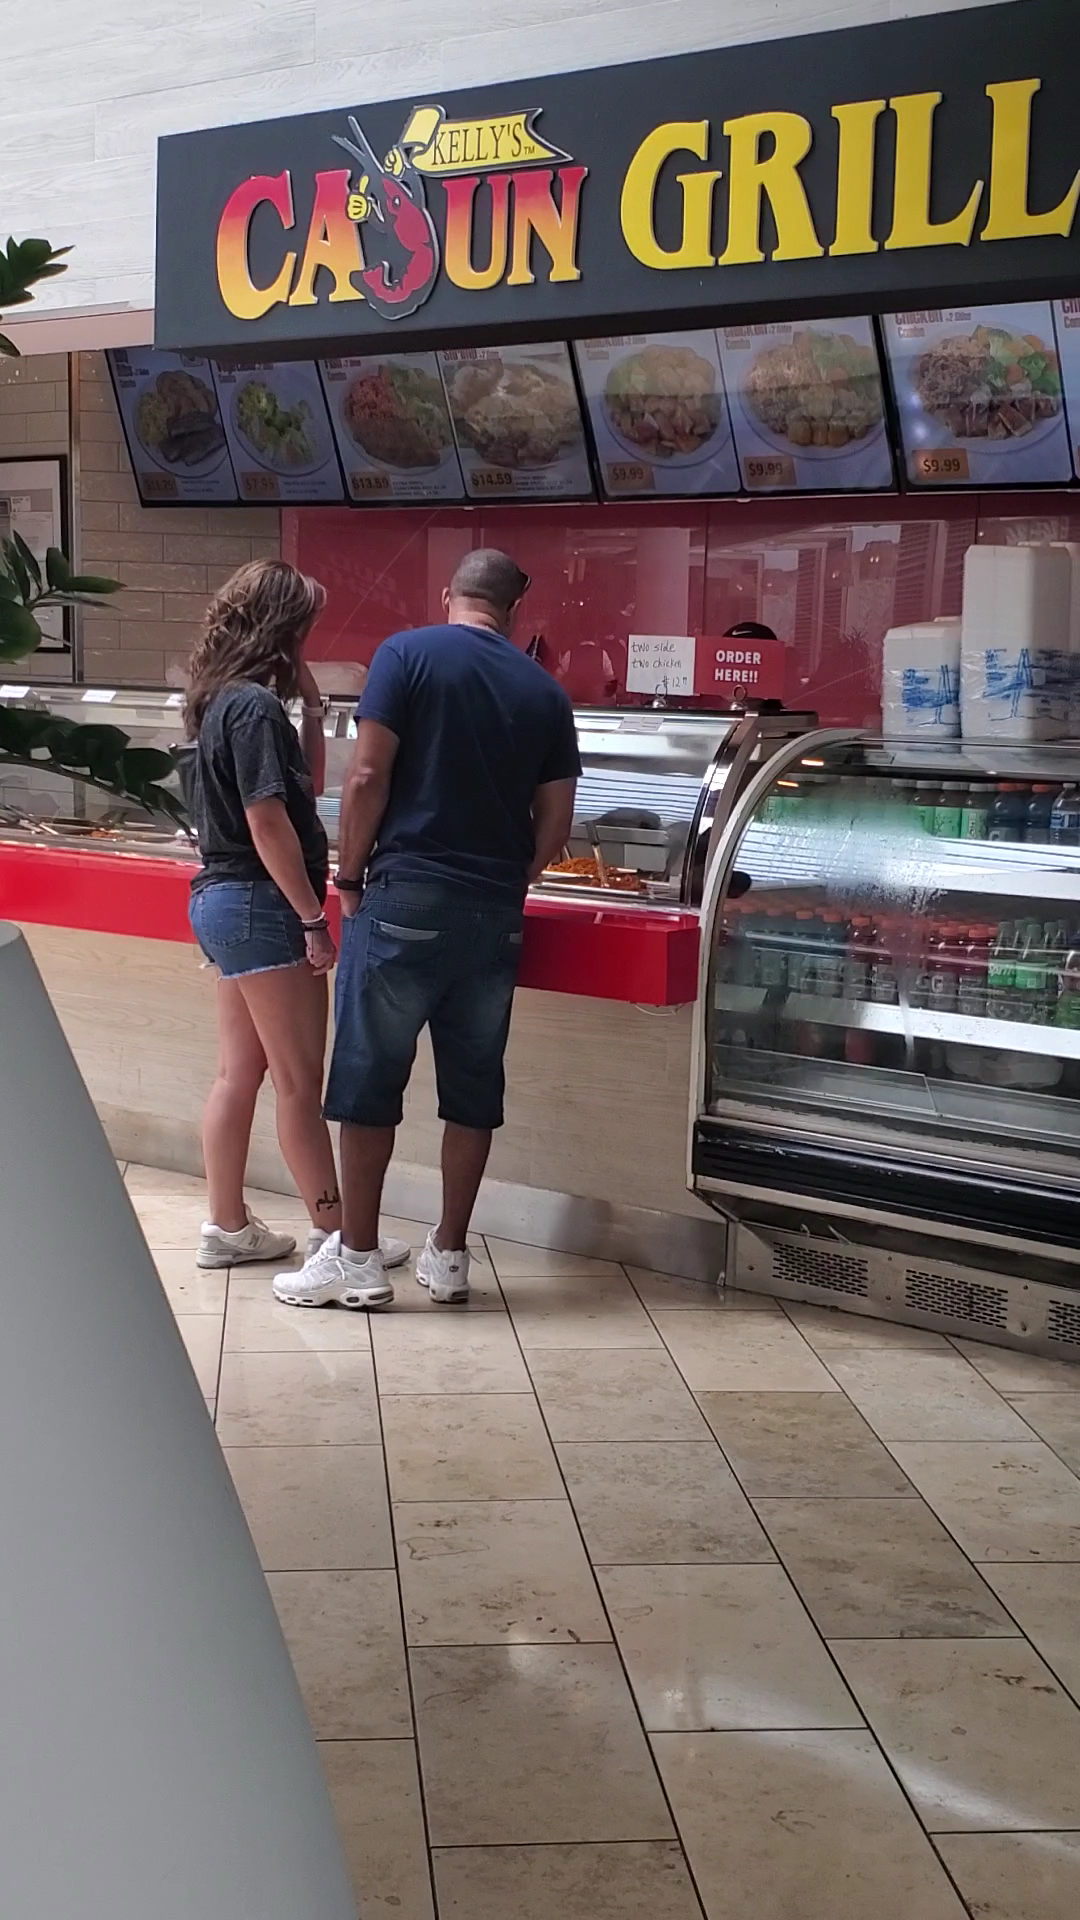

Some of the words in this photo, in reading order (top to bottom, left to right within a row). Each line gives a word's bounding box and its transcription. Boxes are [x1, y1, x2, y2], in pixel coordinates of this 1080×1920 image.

[431, 122, 521, 165] KELLY'S
[217, 166, 588, 320] CAJUN
[620, 78, 1080, 270] GRILL
[612, 466, 644, 481] $9.99
[748, 462, 783, 477] $9.99
[923, 458, 960, 474] $9.99
[631, 641, 649, 652] two
[654, 640, 676, 652] side
[632, 658, 649, 669] two
[653, 657, 681, 669] chicken
[716, 650, 761, 665] ORDER
[714, 668, 758, 683] HERE!!
